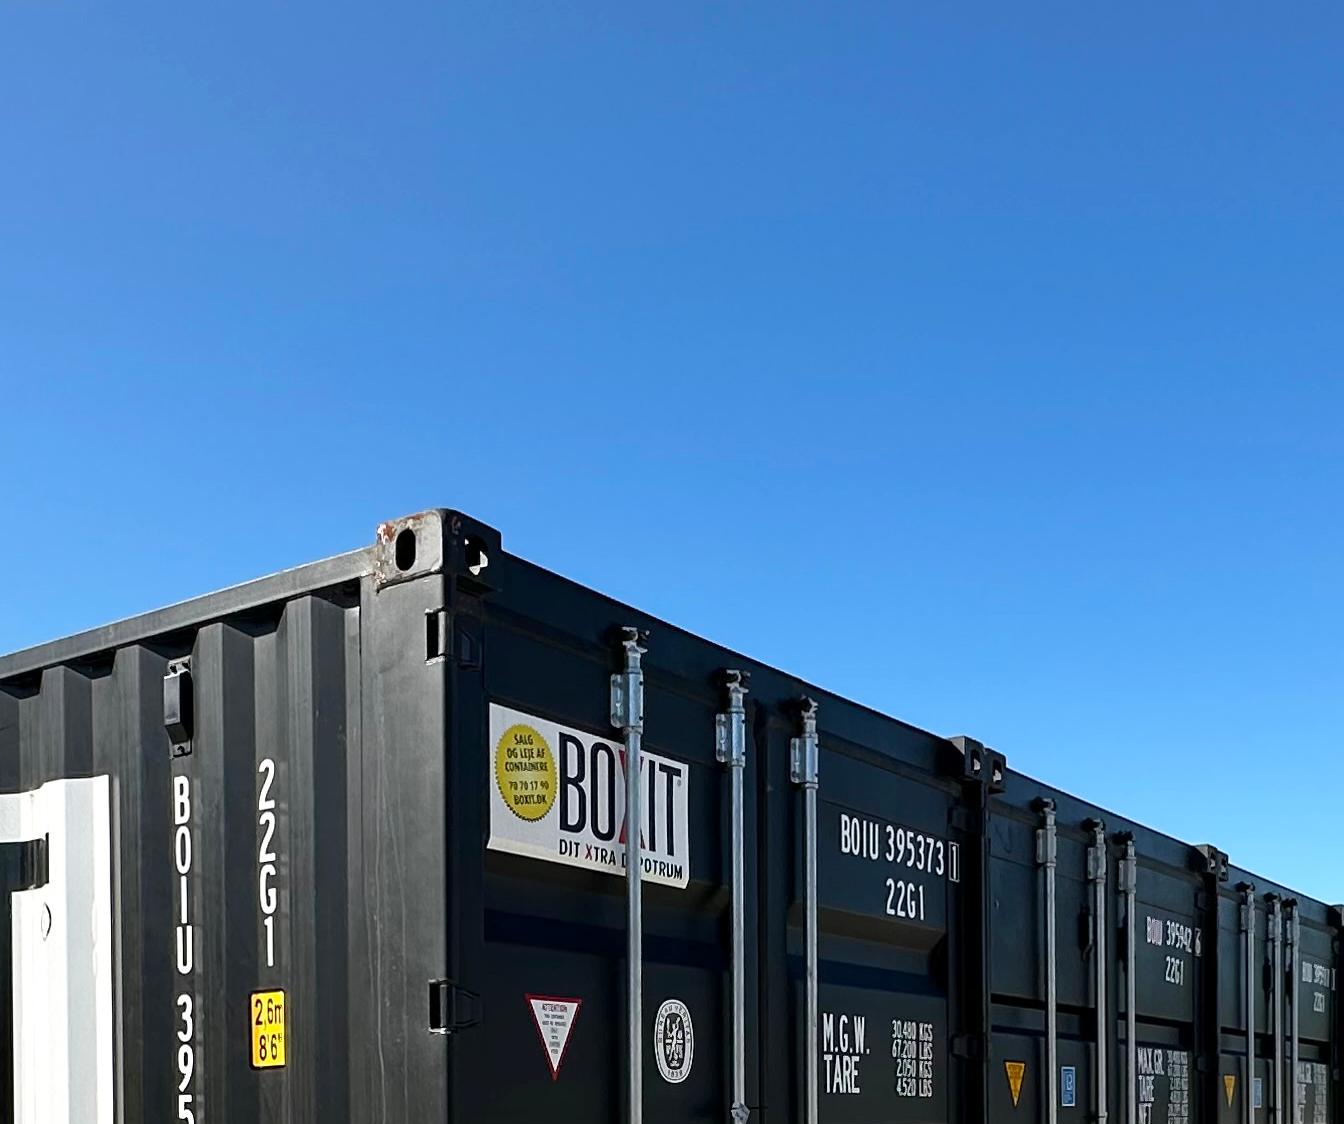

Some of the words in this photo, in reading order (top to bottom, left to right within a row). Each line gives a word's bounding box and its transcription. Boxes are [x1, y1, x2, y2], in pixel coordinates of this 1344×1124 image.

[258, 758, 277, 968] 22G1
[559, 838, 581, 859] DIT
[585, 843, 616, 867] XTRA
[621, 851, 683, 880] DOTRUM
[841, 813, 879, 861] BOIU
[885, 824, 944, 876] 395373
[173, 775, 193, 975] BOIU
[886, 877, 924, 921] 22G1
[822, 1012, 871, 1055] M.G.W.
[823, 1054, 861, 1094] TARE
